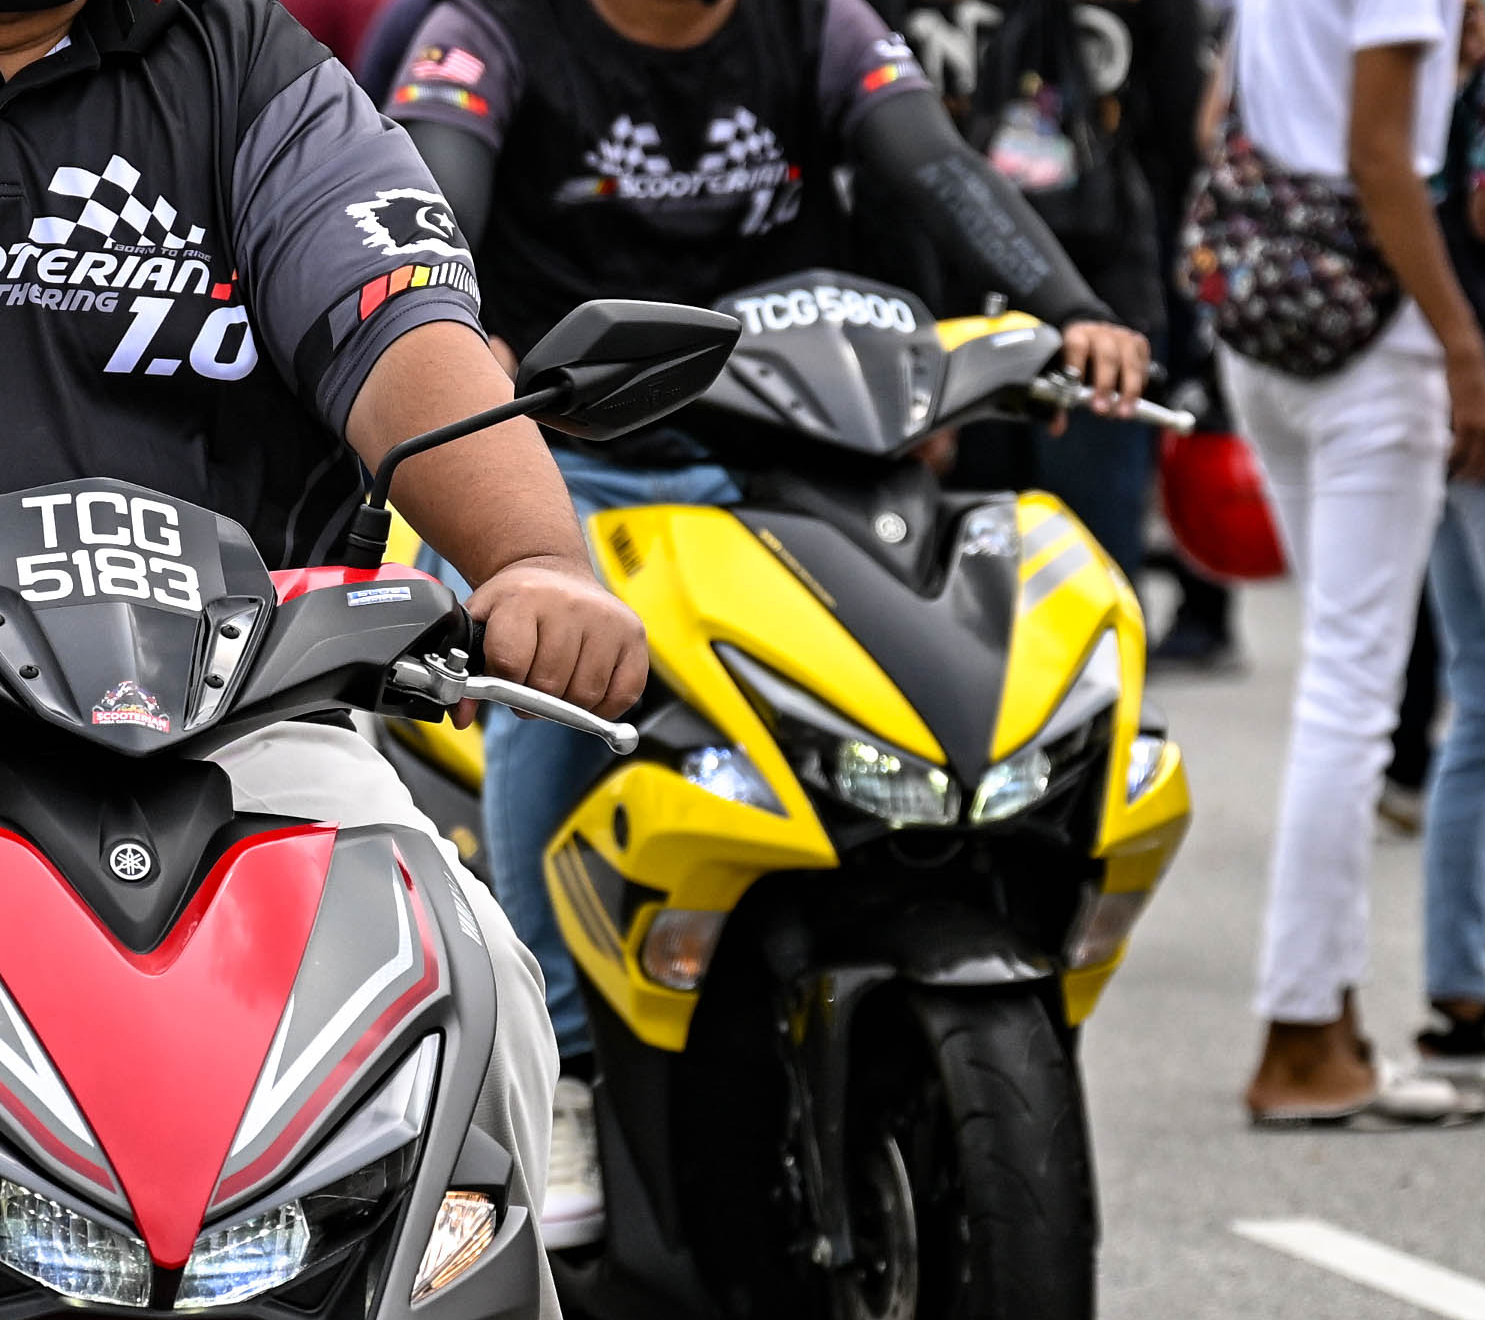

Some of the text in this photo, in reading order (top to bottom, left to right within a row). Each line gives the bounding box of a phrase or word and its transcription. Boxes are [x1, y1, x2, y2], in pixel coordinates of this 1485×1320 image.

[114, 243, 212, 263] BORN TO RIDE
[103, 296, 259, 381] 1.0
[21, 491, 182, 557] TCG
[16, 547, 203, 612] 5183
[95, 711, 168, 728] SCOOTERIAN
